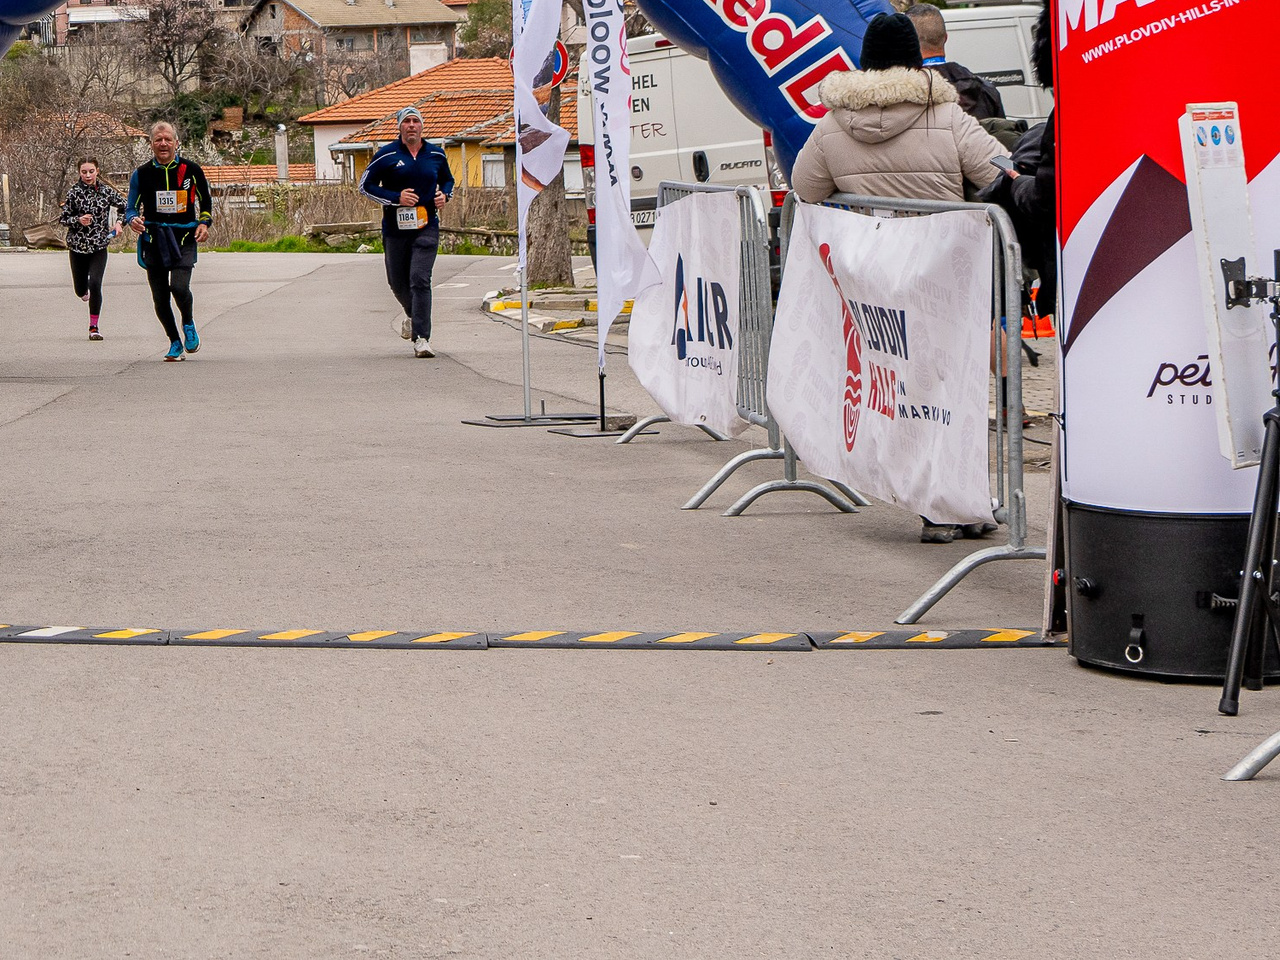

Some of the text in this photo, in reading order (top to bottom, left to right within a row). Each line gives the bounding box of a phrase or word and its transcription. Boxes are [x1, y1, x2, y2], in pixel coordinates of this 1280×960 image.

[631, 73, 658, 90] HEL
[631, 98, 651, 113] EN
[630, 122, 668, 139] TER
[720, 159, 763, 171] DUCATO
[158, 197, 174, 205] 1315
[897, 379, 907, 396] IN
[1166, 394, 1213, 405] STUD
